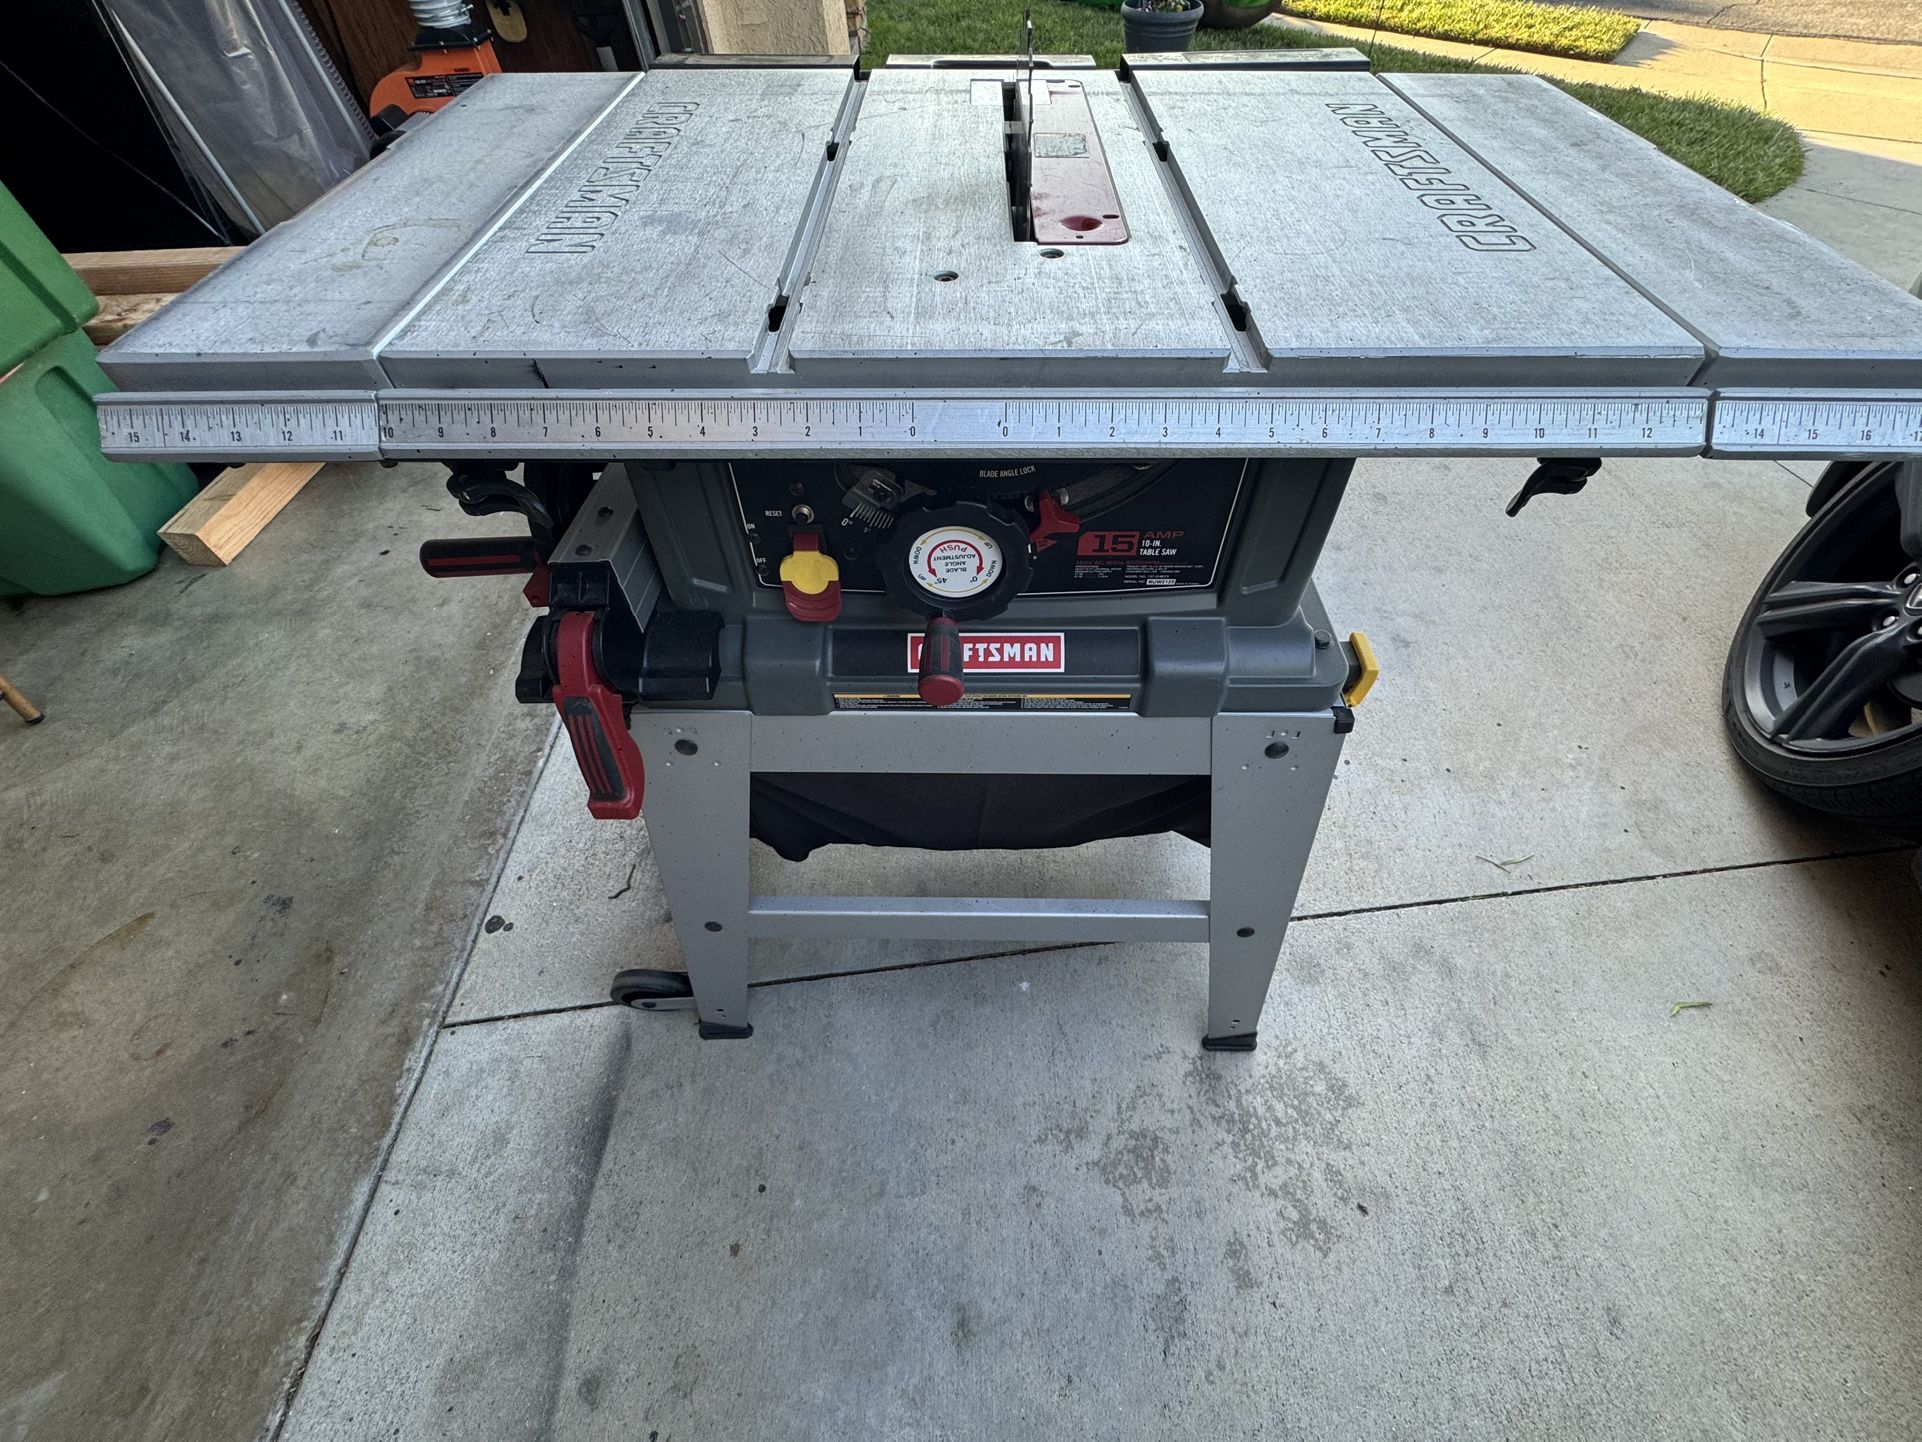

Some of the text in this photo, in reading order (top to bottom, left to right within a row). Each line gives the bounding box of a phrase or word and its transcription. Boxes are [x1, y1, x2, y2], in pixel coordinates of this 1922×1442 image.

[526, 102, 700, 253] CRAFTSMAN
[1325, 103, 1537, 251] CRAFTSMAN
[128, 430, 342, 442] 15 14 13 12 11
[382, 426, 1652, 438] 10 9 8 7 6 5 4 3 2 1 0 0 1 2 3 4 5 6 7 8 9 10 11 12
[1755, 428, 1764, 438] 14
[1808, 429, 1817, 439] 15
[1861, 430, 1871, 440] 16
[979, 465, 1036, 478] BLADE ANGLE LOCK
[984, 541, 993, 550] UP
[1092, 531, 1184, 553] 15 AMP
[913, 546, 922, 565] DOWN
[940, 544, 968, 554] PUSH
[1160, 548, 1178, 556] SAW
[986, 560, 997, 577] DOWN
[917, 643, 1054, 663] FTSMAN
